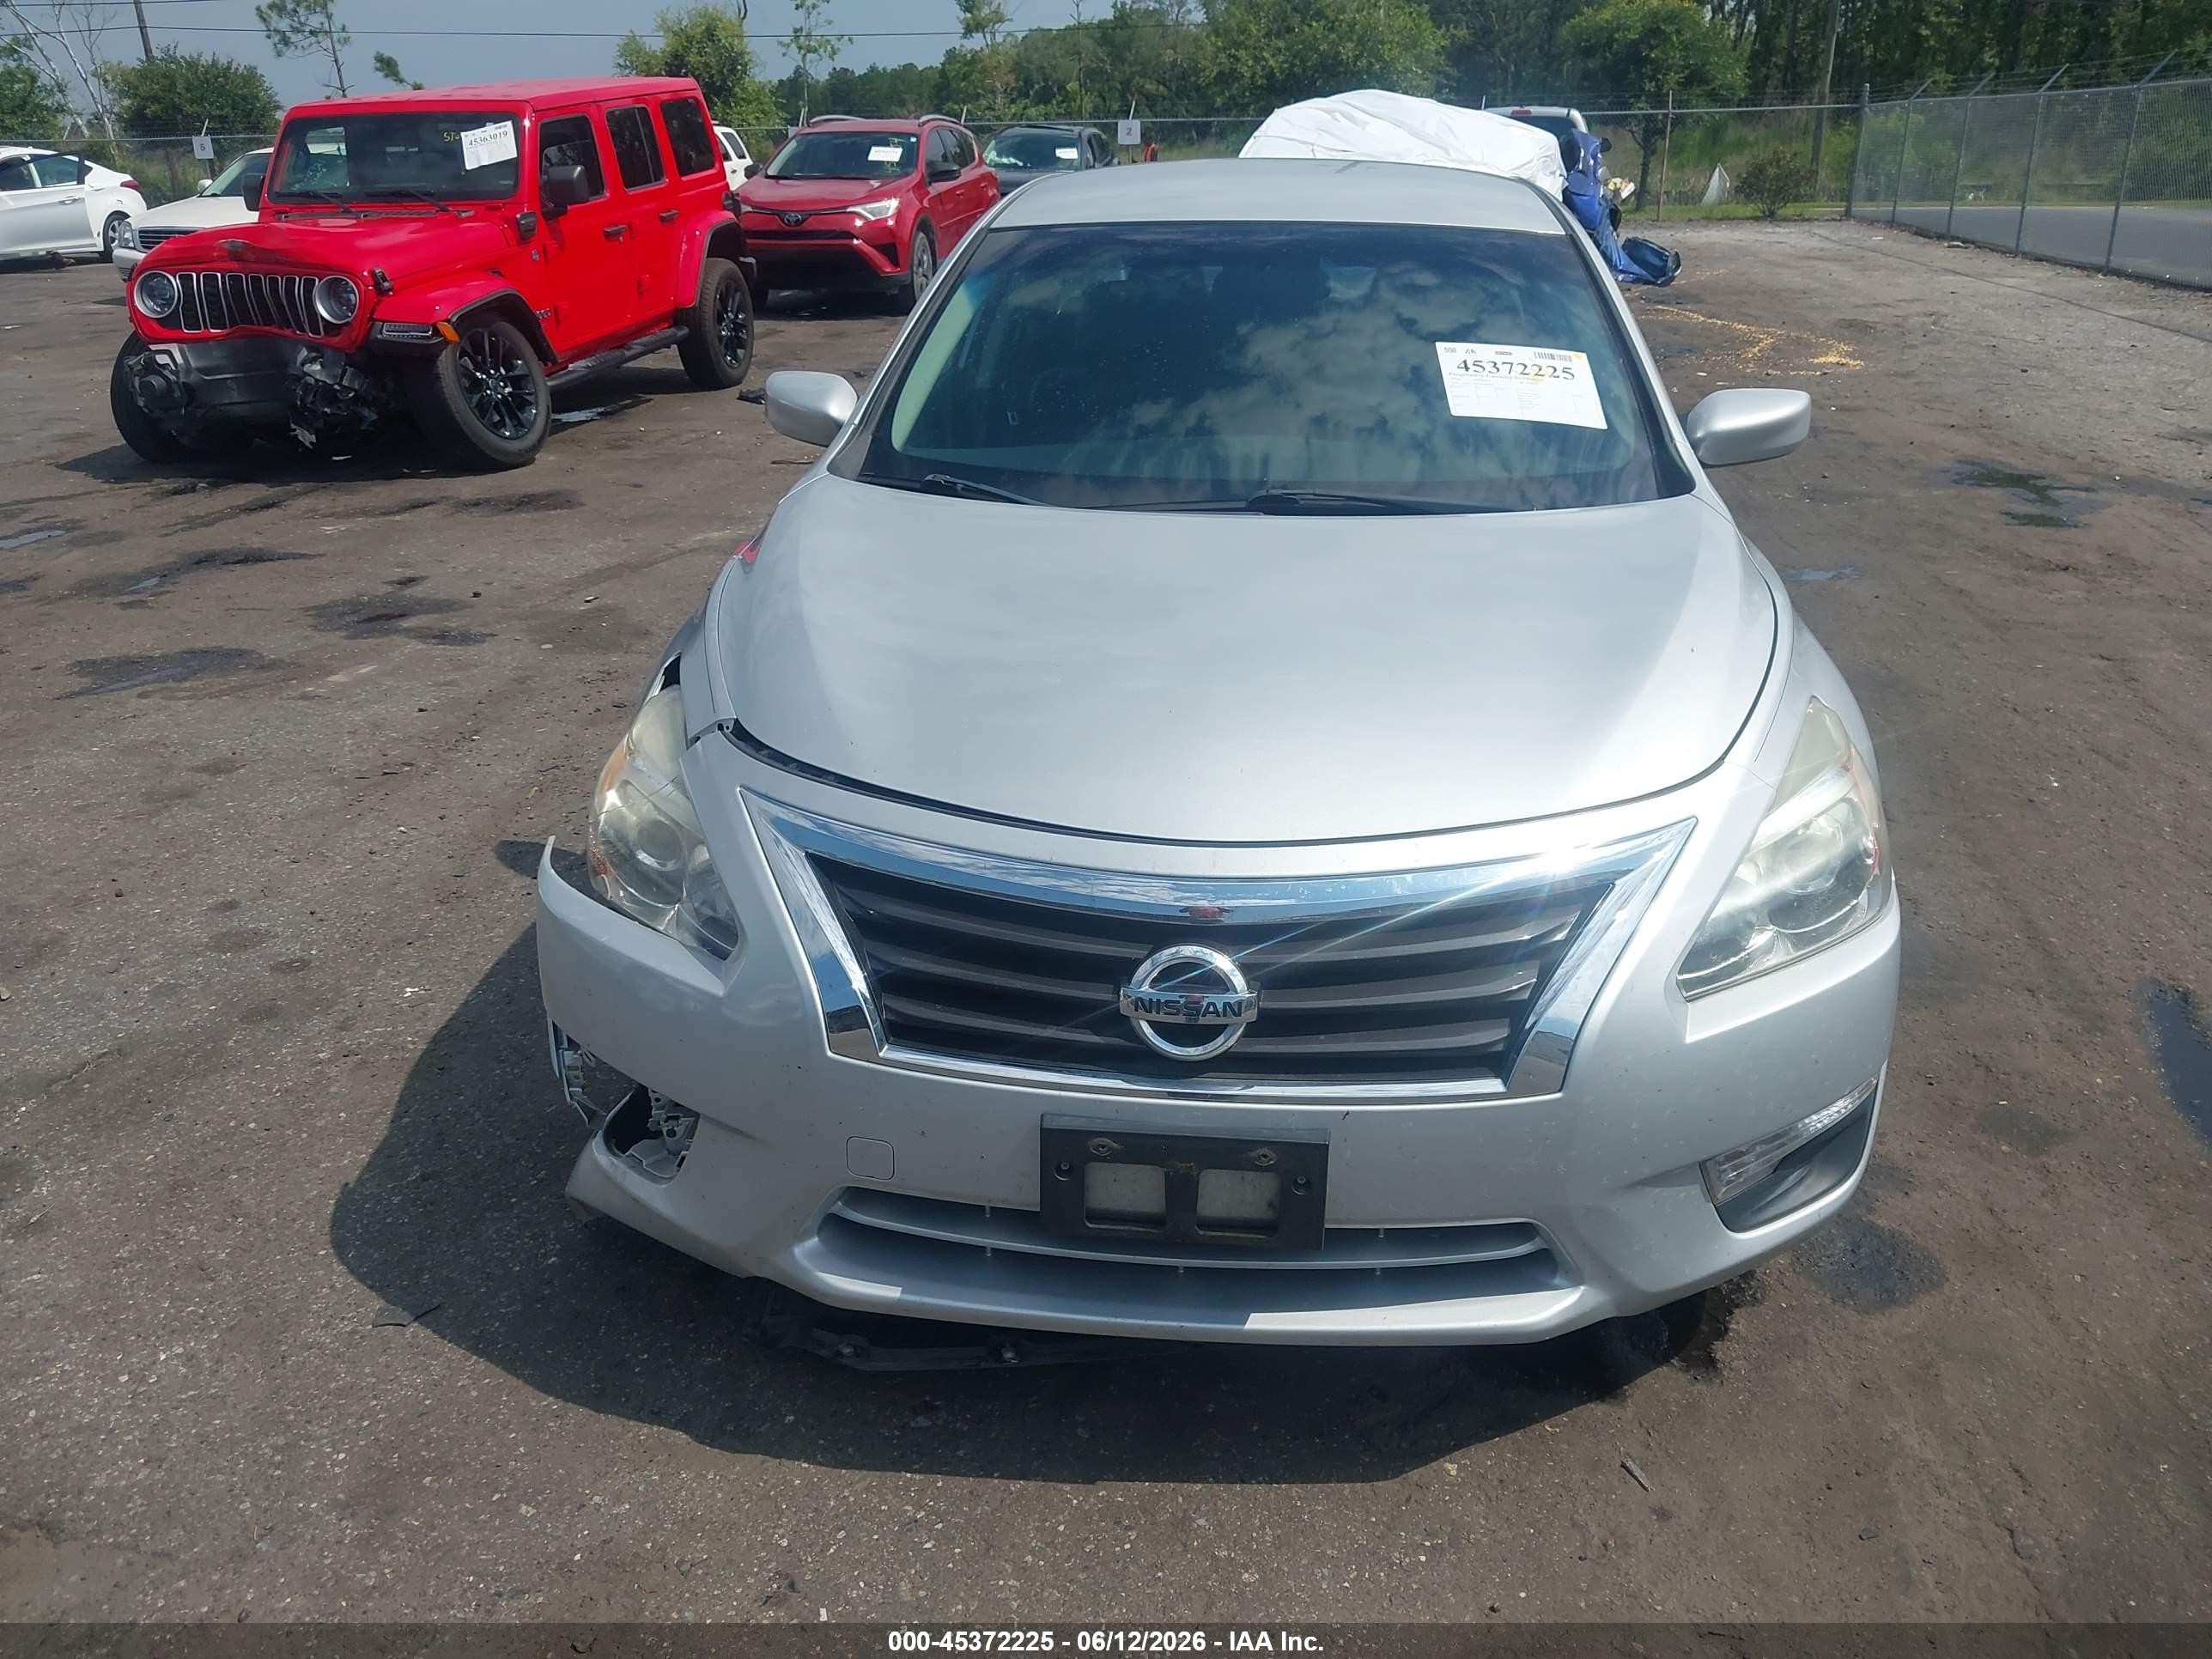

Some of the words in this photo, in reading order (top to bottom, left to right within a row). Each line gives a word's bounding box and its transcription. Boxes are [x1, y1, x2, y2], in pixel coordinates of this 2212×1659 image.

[468, 131, 508, 147] 45363019
[1126, 127, 1133, 137] 2
[1456, 359, 1576, 380] 45372225
[1133, 997, 1243, 1018] NISSAN
